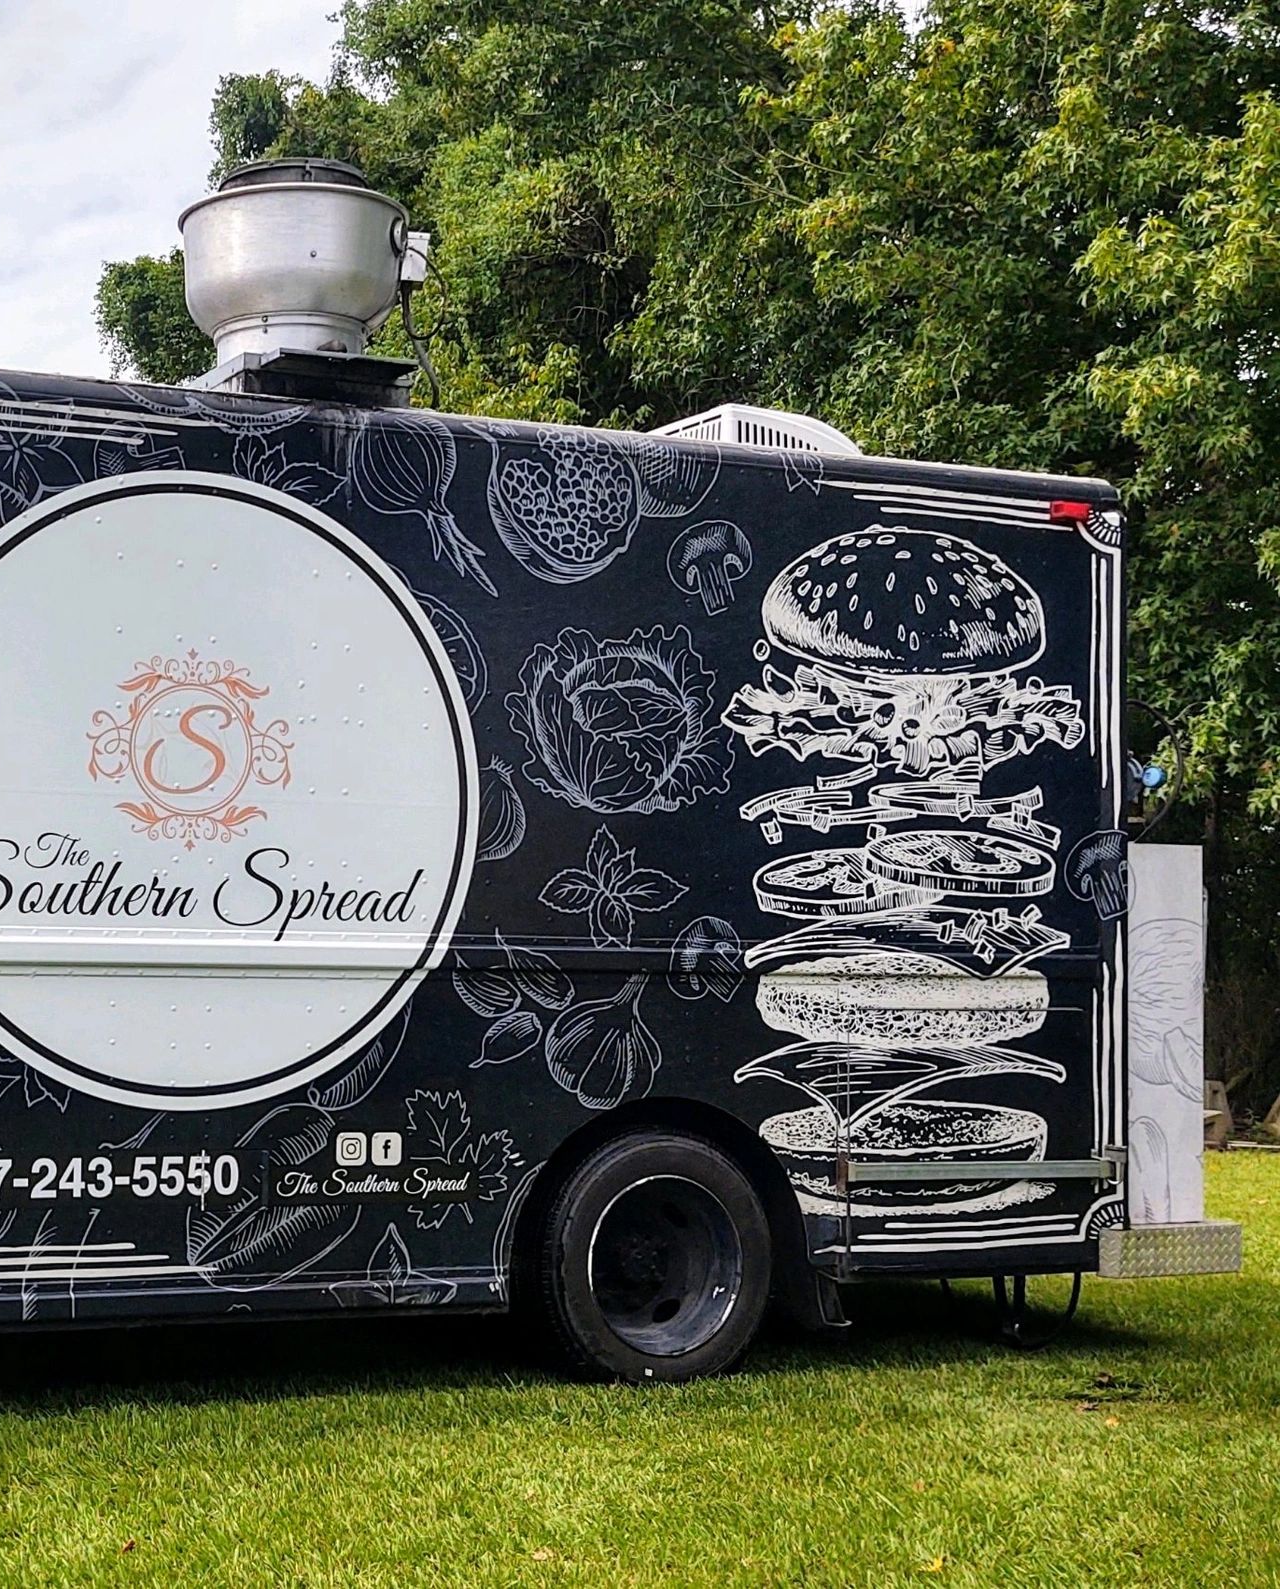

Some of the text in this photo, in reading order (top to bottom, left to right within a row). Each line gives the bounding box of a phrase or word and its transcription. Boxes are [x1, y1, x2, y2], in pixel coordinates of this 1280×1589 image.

[143, 703, 233, 795] S
[23, 832, 90, 869] The
[212, 847, 425, 942] Spread
[276, 1167, 471, 1200] The Southern Spread
